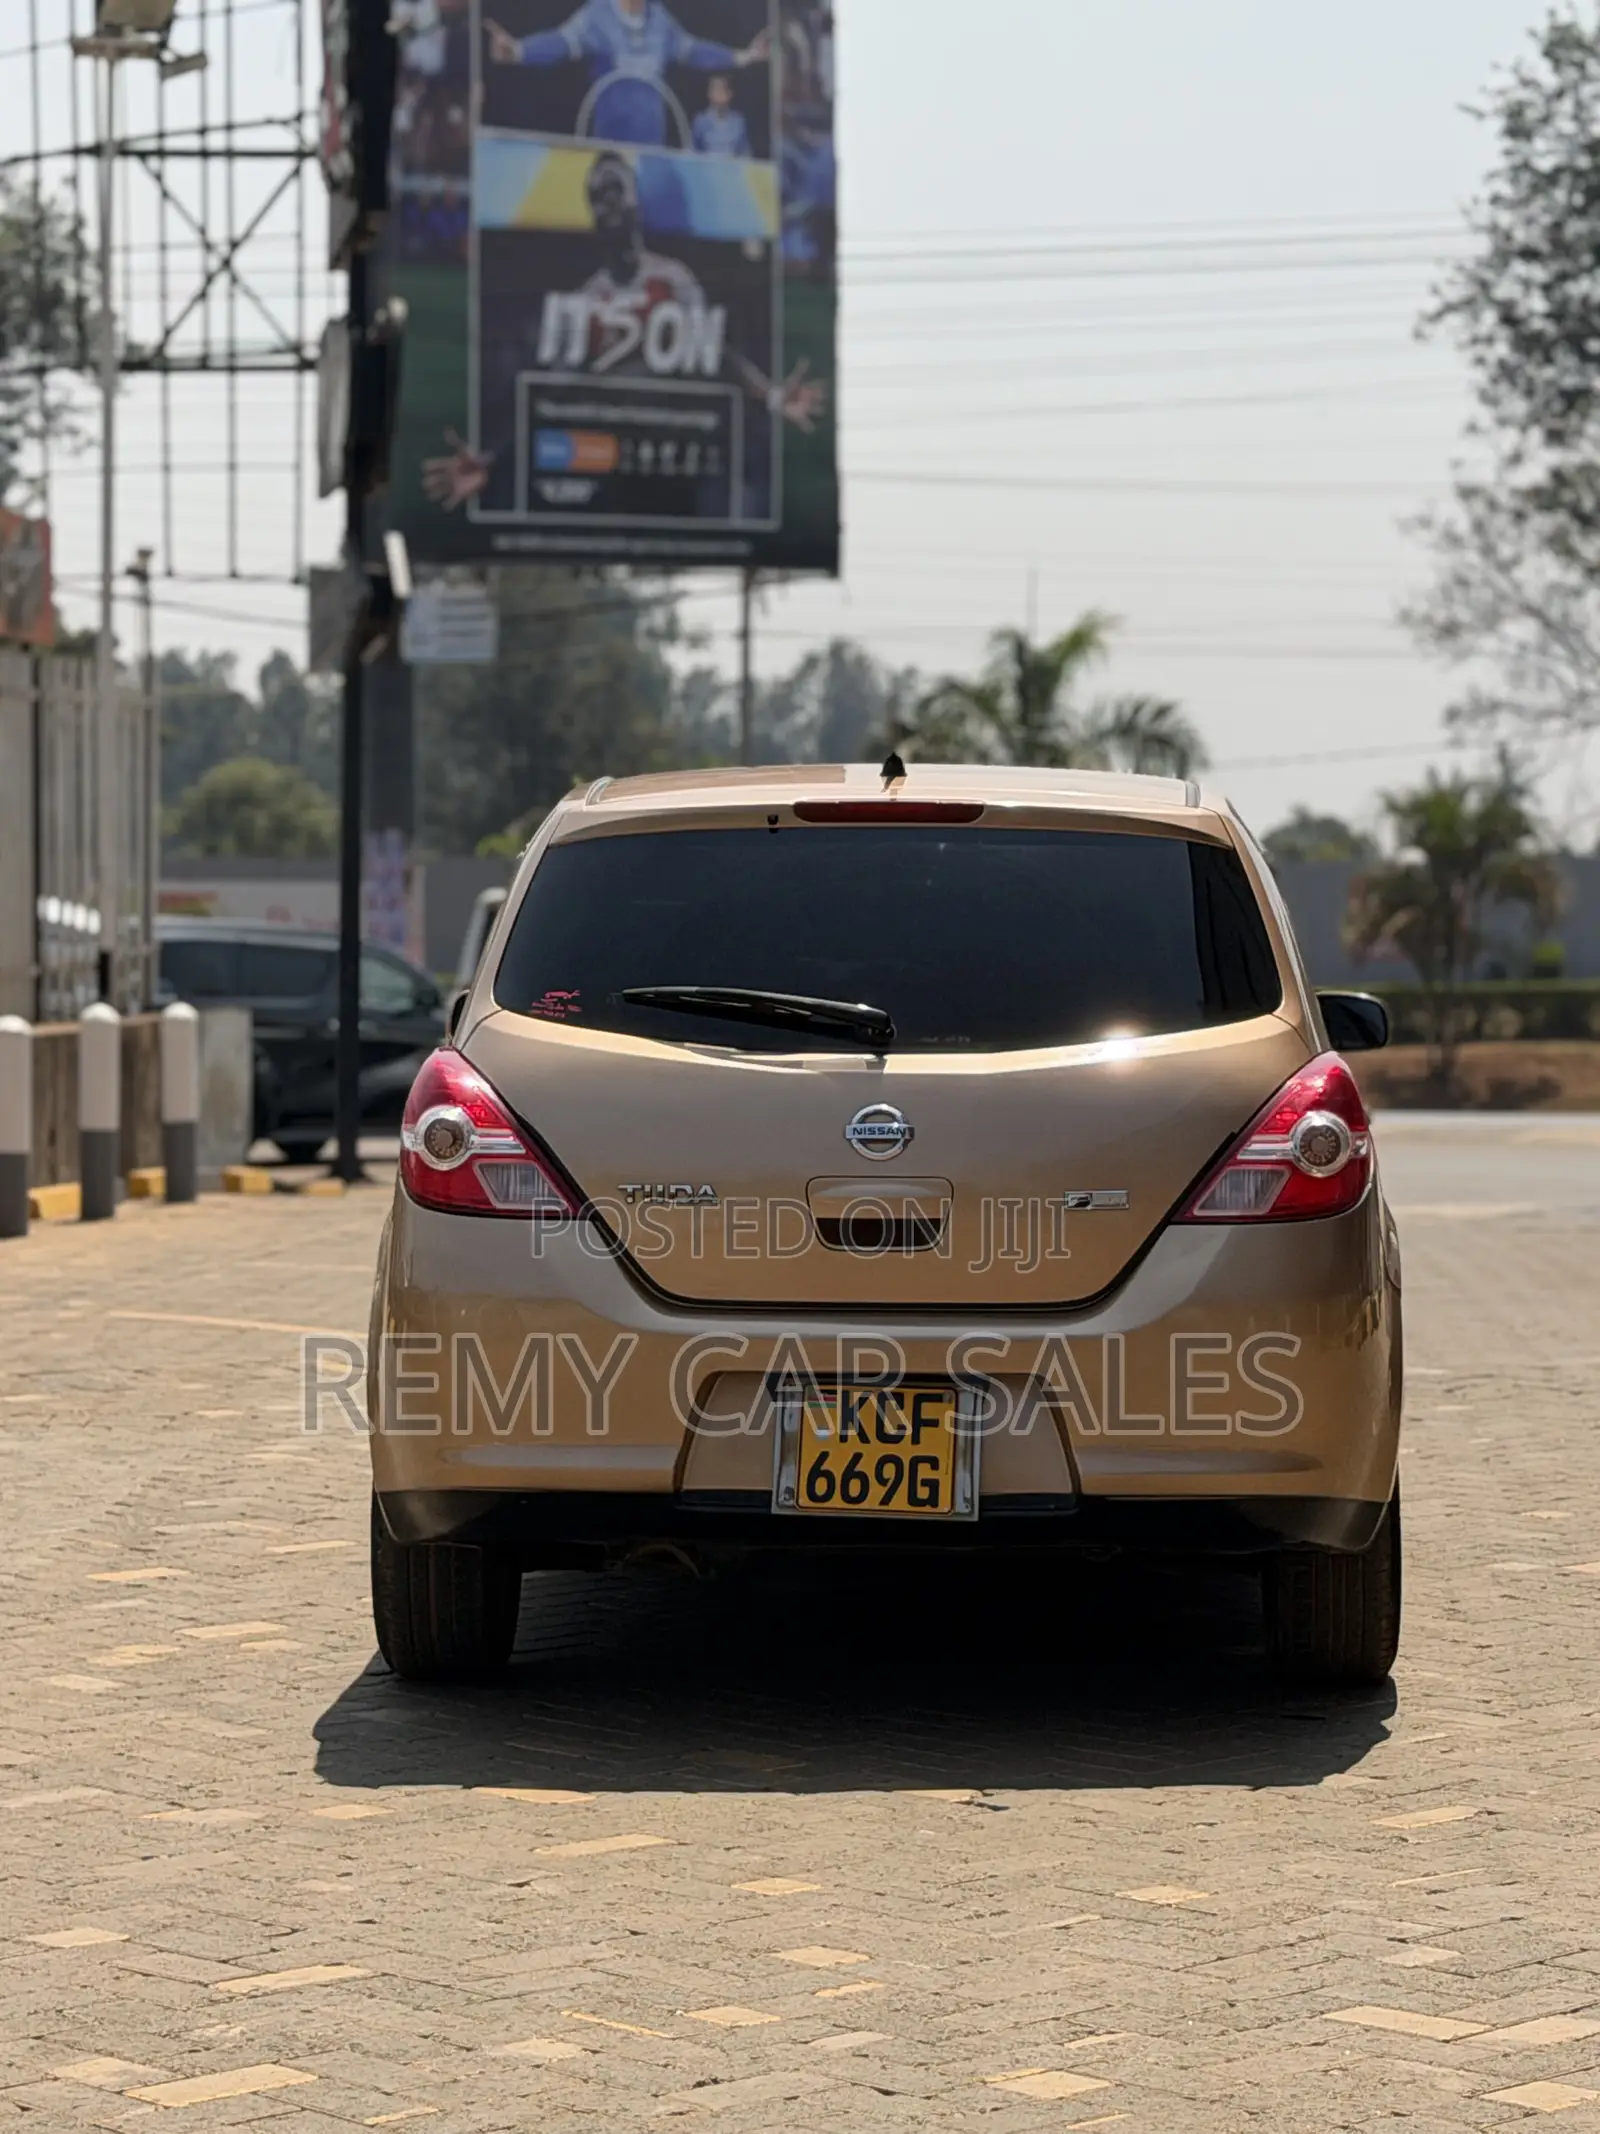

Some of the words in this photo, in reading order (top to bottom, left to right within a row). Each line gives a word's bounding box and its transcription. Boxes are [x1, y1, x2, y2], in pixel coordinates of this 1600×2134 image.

[852, 1126, 906, 1136] NISSAN
[618, 1184, 719, 1204] TIIDA
[839, 1390, 944, 1445] KCF
[806, 1451, 940, 1508] 669G
